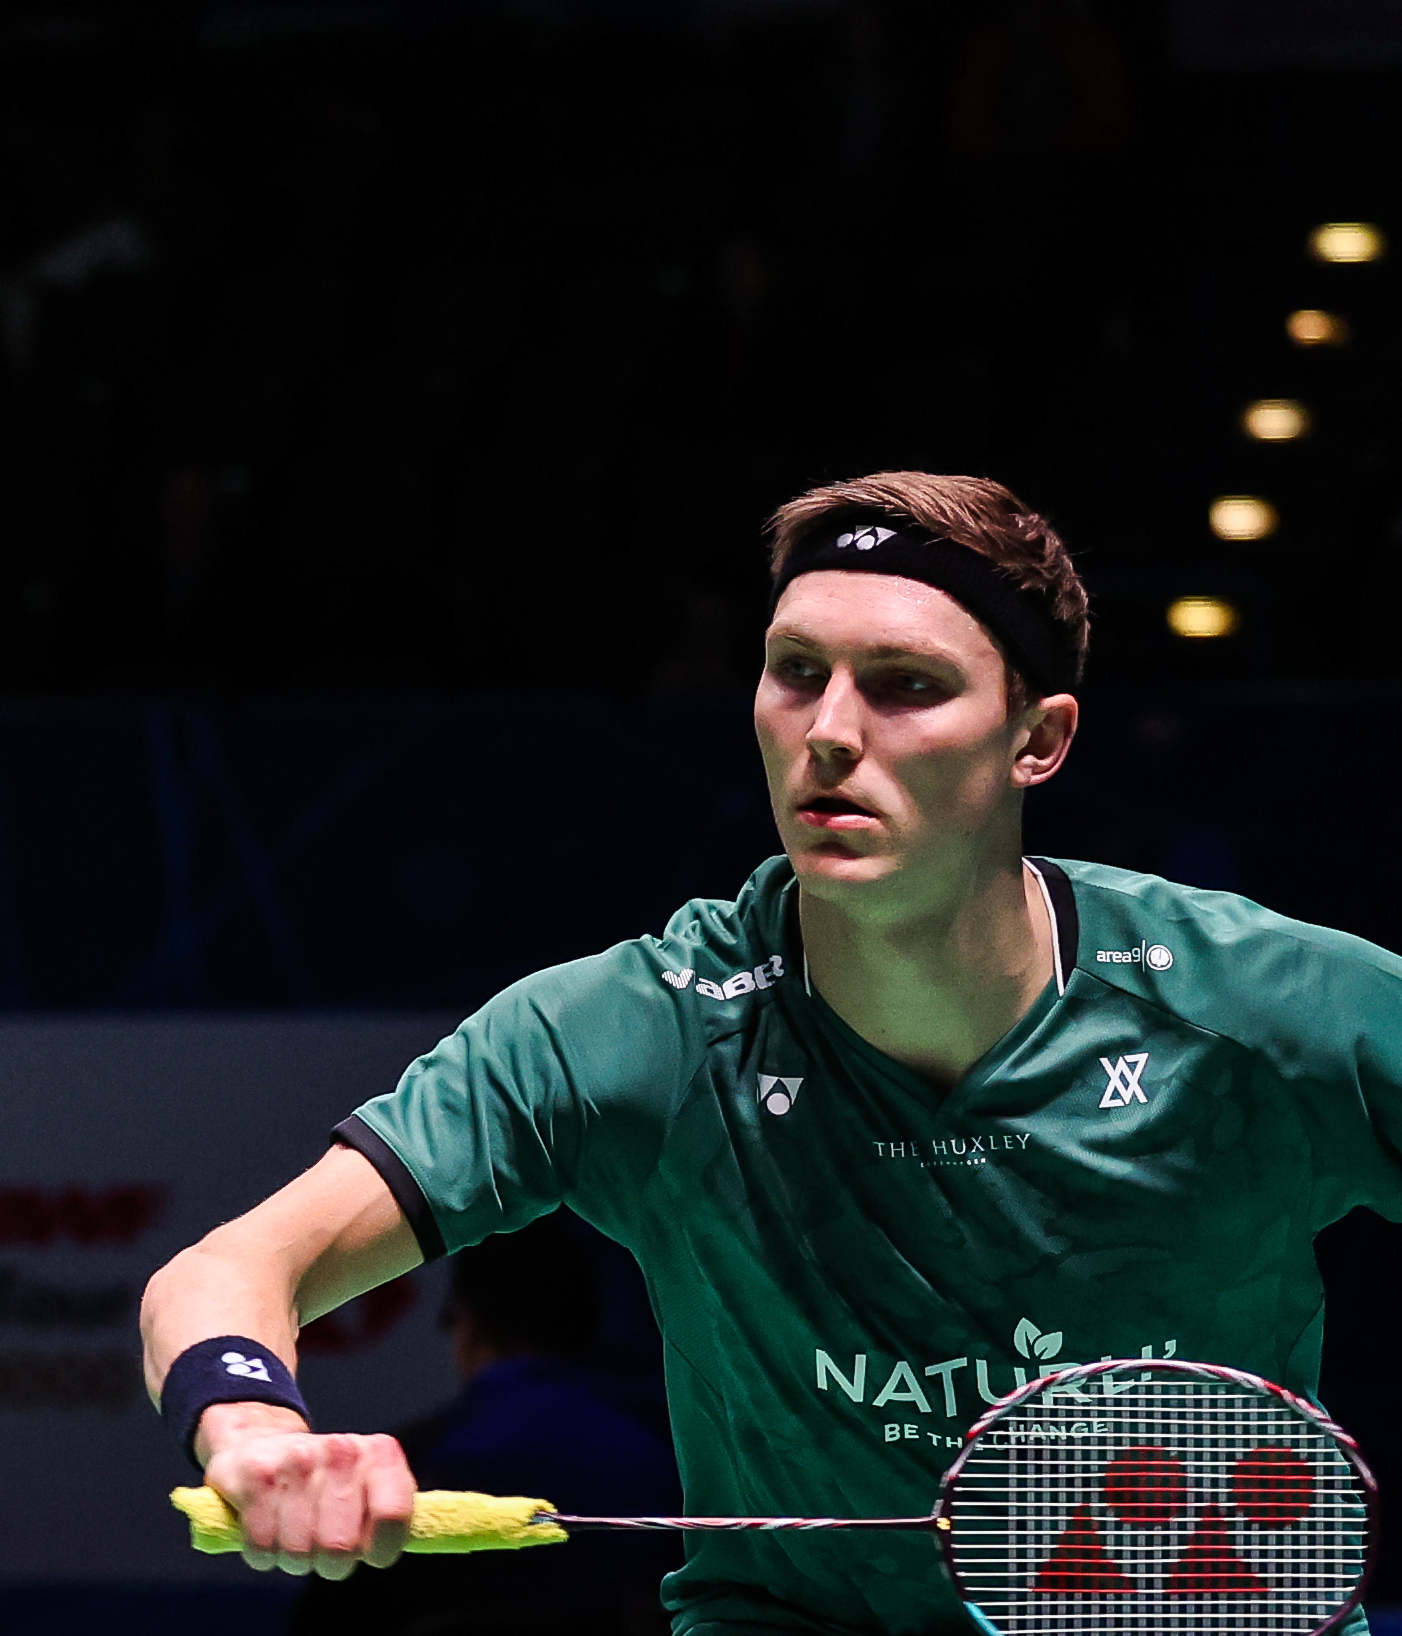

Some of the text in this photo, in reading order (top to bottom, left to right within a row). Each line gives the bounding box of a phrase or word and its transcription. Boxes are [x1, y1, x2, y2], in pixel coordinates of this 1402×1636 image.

[872, 1132, 1031, 1158] THE HUXLEY
[884, 1423, 920, 1443] BE
